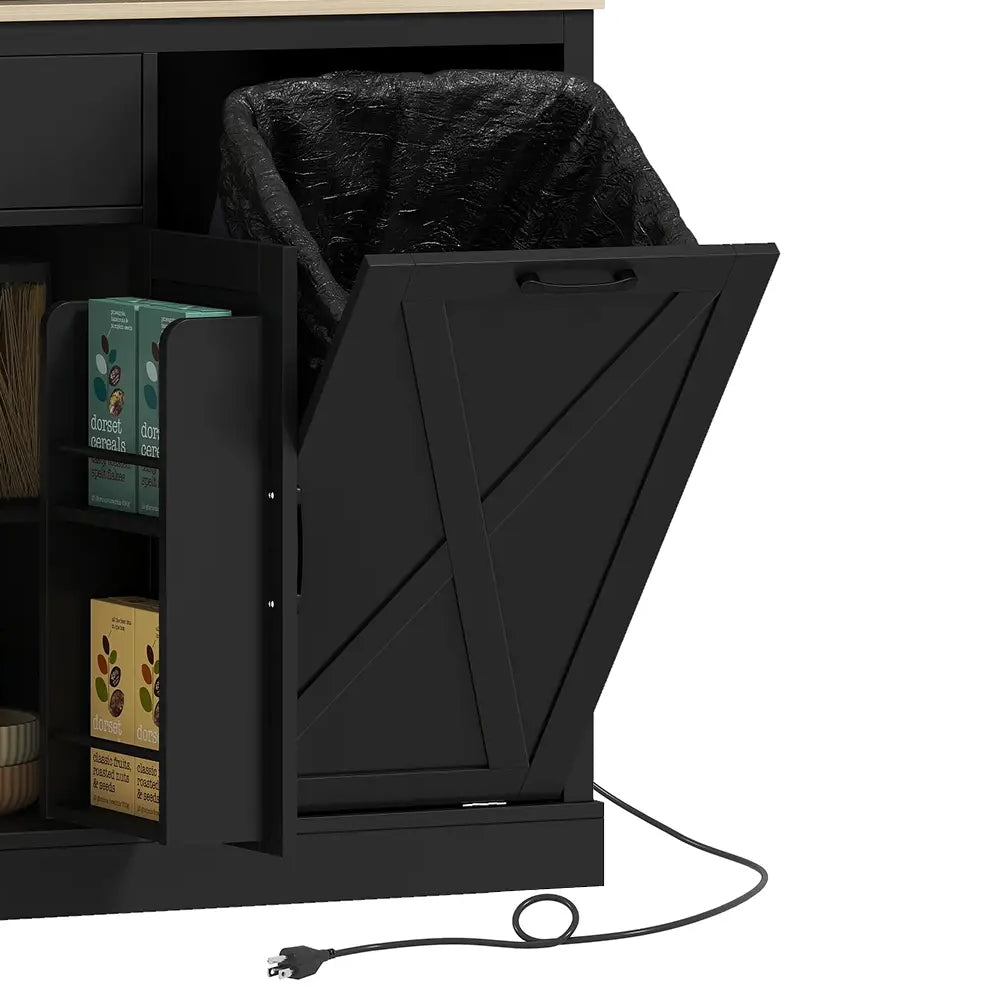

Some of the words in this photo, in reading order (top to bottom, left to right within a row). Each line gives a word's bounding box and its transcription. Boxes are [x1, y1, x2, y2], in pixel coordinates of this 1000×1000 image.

[90, 414, 123, 435] dorset
[90, 436, 126, 453] cereals
[93, 714, 122, 736] dorset
[136, 724, 159, 744] dors
[93, 752, 113, 766] classic
[93, 767, 115, 780] roasted
[136, 762, 158, 777] classic
[99, 782, 116, 793] seeds
[136, 788, 143, 800] &
